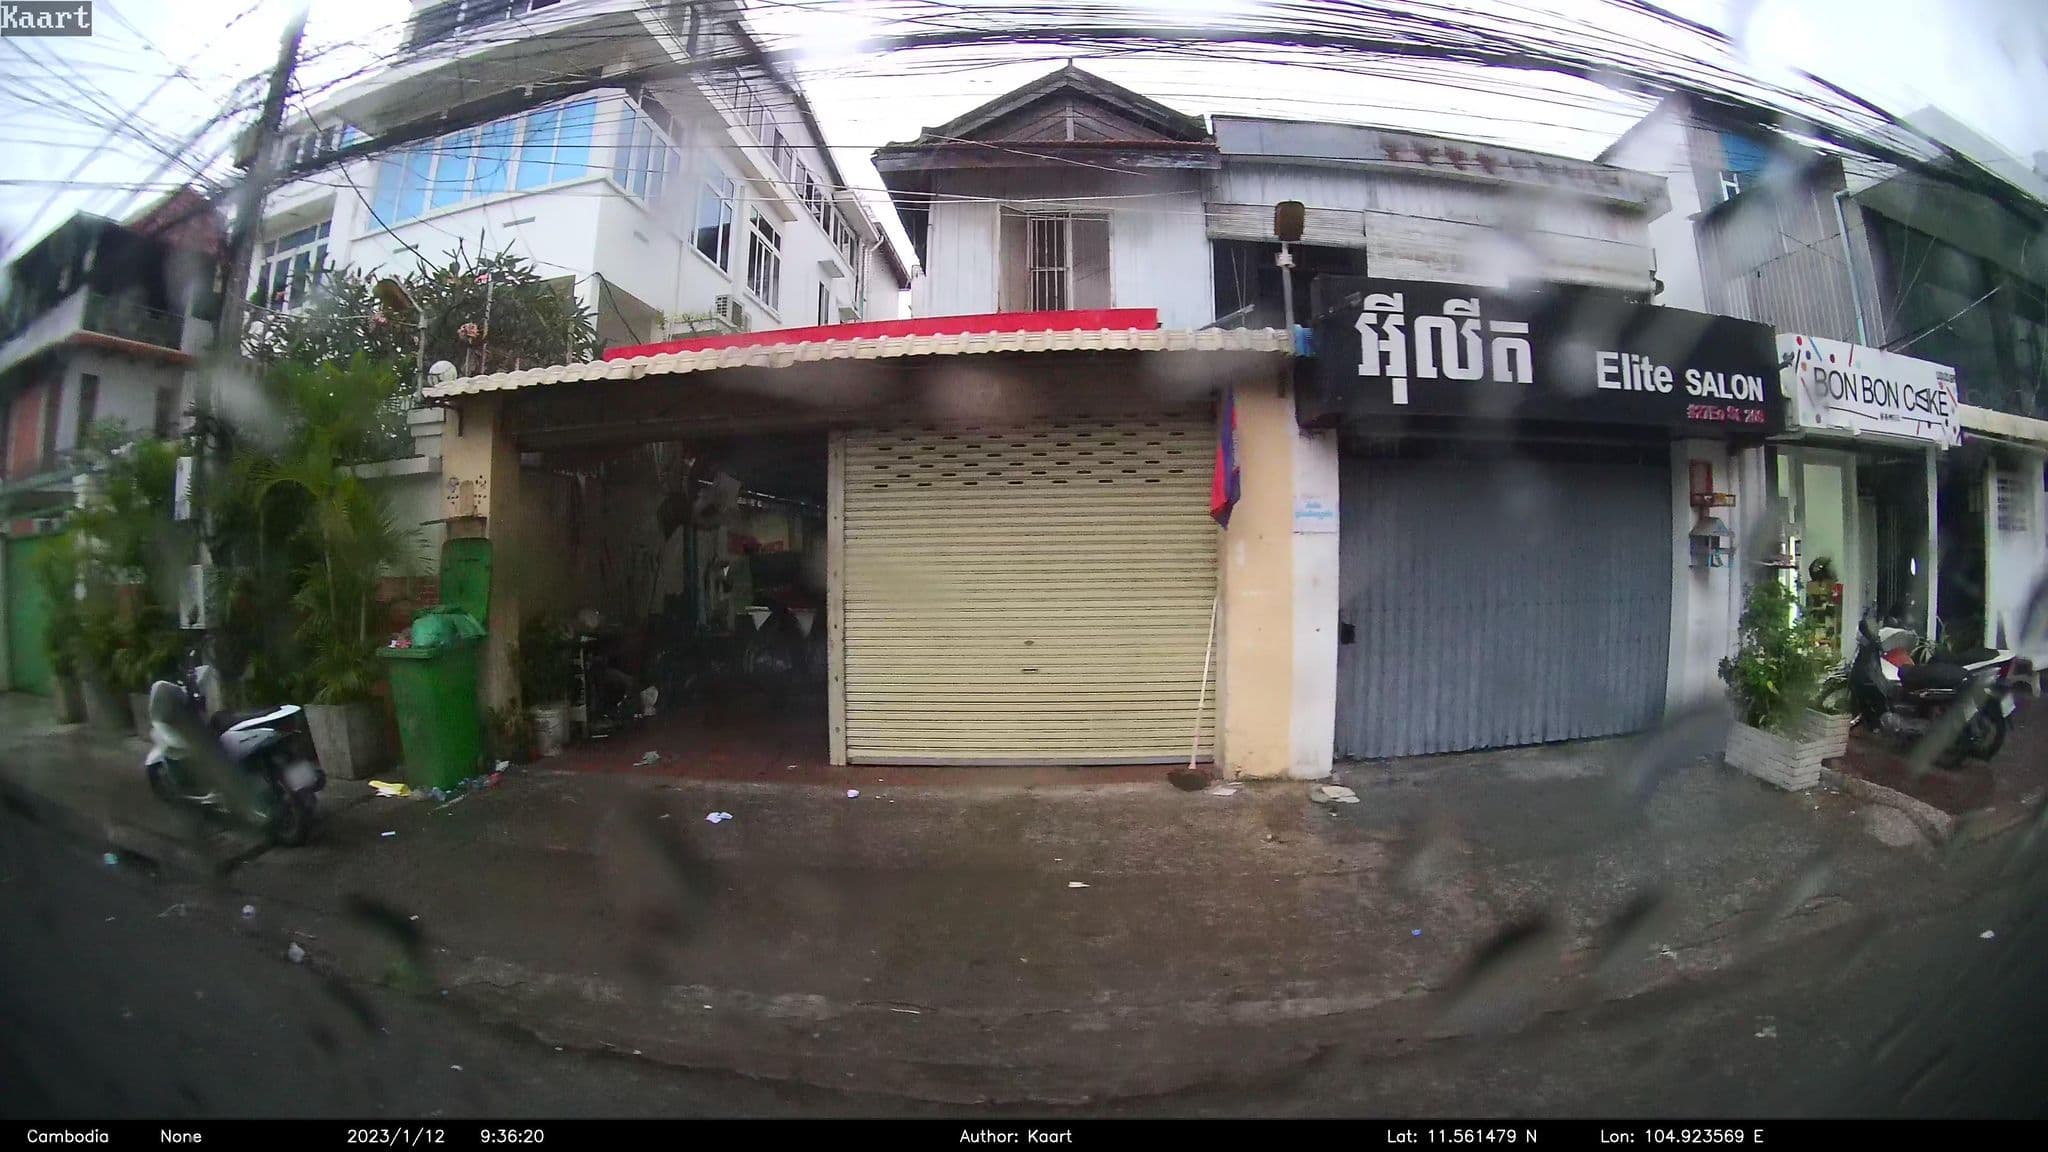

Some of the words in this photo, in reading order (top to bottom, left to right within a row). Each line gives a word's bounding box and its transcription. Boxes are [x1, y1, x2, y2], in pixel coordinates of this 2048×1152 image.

[1595, 350, 1674, 394] Elite
[1684, 368, 1765, 403] SALON
[1813, 366, 1858, 402] BON
[1861, 375, 1900, 409] BON
